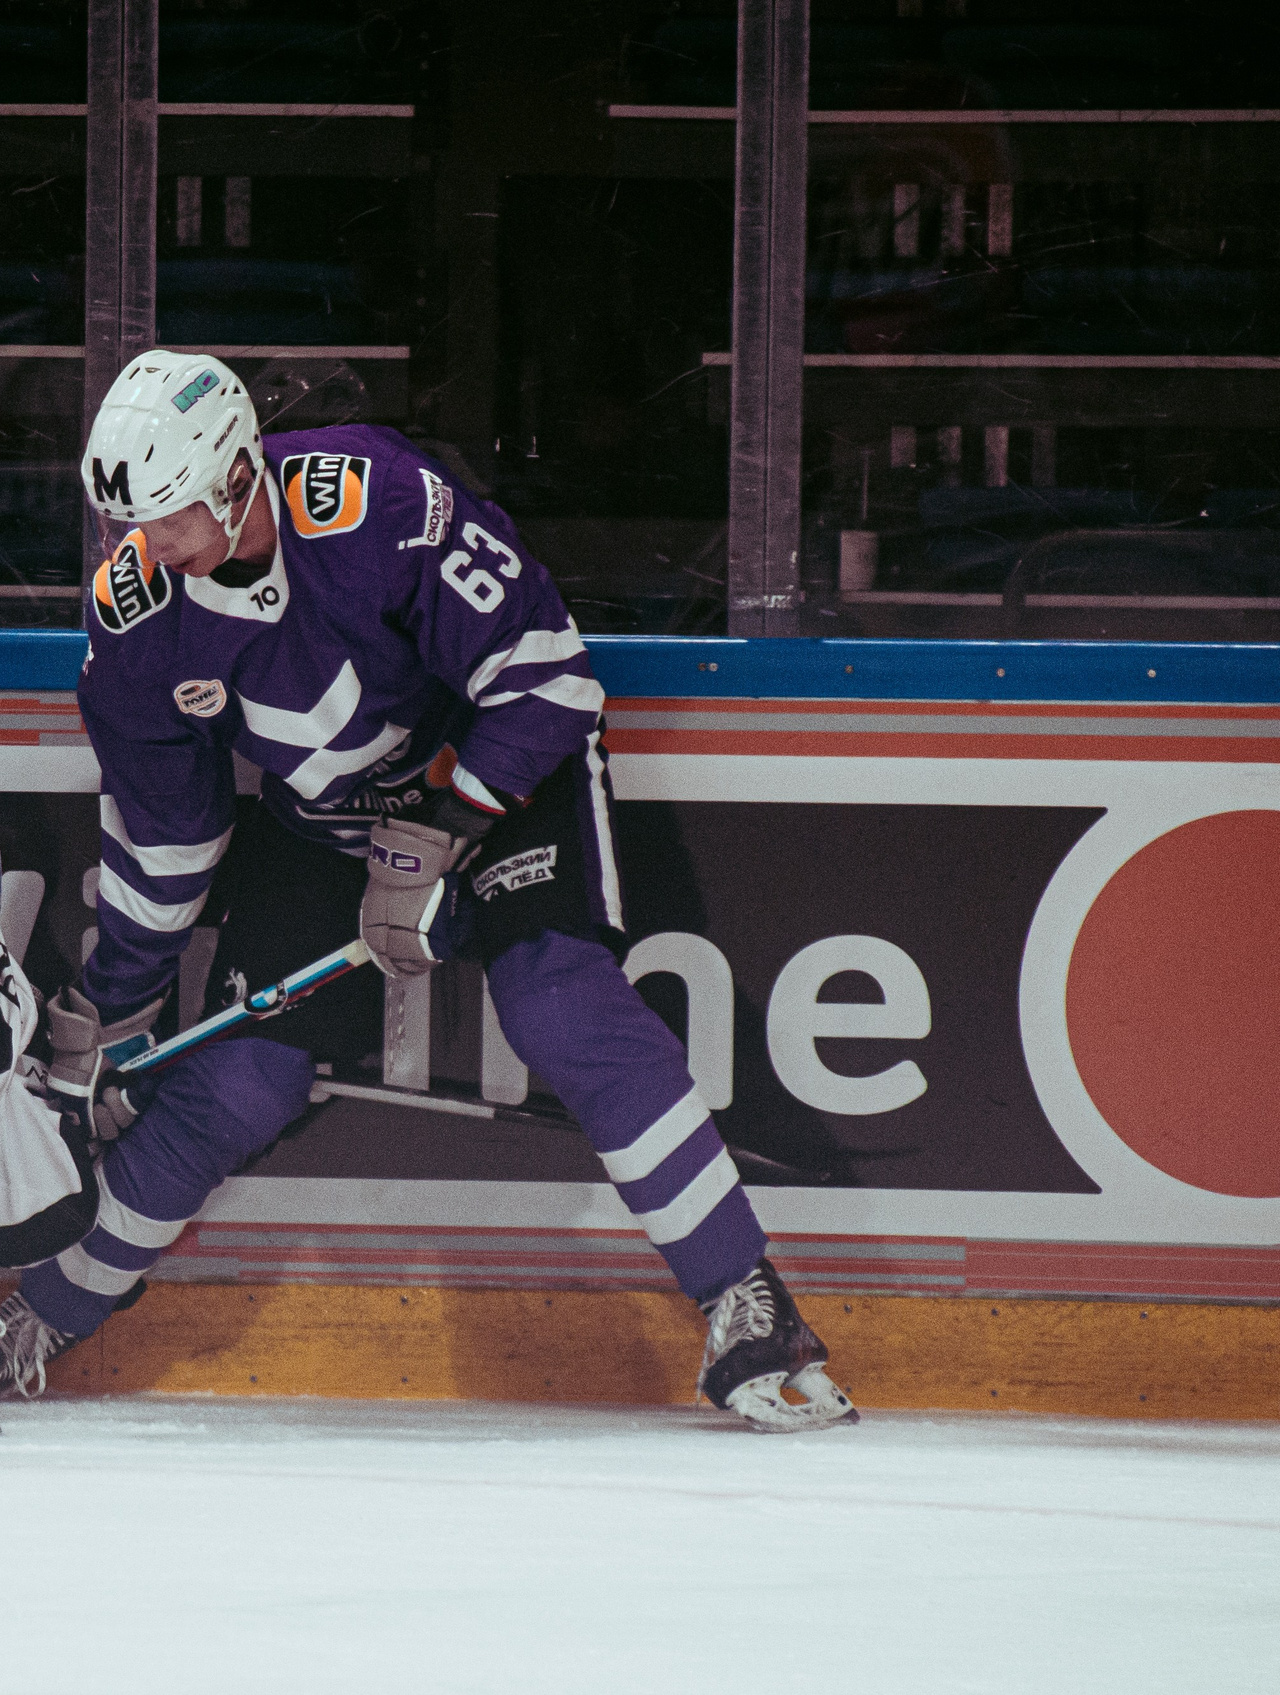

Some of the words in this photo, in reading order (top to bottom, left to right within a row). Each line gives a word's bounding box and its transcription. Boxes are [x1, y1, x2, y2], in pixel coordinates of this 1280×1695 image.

[440, 522, 522, 613] 63
[250, 585, 280, 612] 10
[510, 869, 548, 888] ЛЁД
